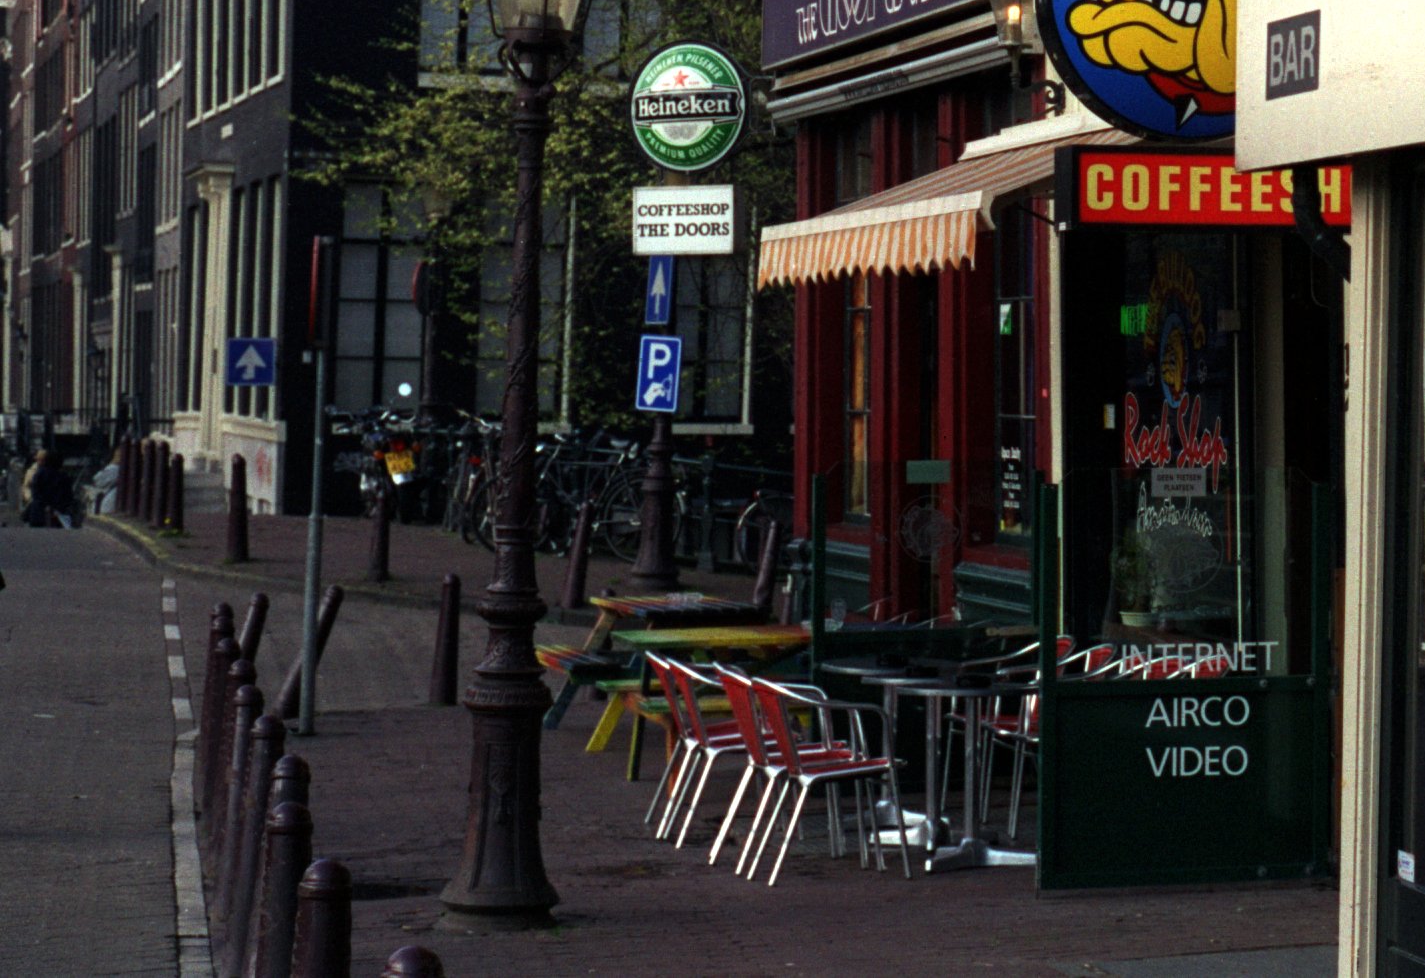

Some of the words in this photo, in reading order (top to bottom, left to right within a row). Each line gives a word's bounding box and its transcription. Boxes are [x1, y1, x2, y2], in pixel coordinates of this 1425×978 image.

[796, 3, 818, 44] THE
[1269, 25, 1316, 87] BAR
[638, 94, 731, 118] Heineken
[645, 131, 685, 159] PREMIUM
[689, 128, 725, 158] QUALITY
[637, 203, 730, 217] COFFEESHOP
[637, 223, 670, 237] THE
[674, 222, 730, 237] DOORS
[647, 343, 672, 379] P
[1124, 391, 1172, 469] Rock
[1176, 392, 1228, 494] Shop
[1121, 641, 1279, 673] INTERNET
[1145, 695, 1250, 728] AIRCO
[1145, 745, 1249, 777] VIDEO
